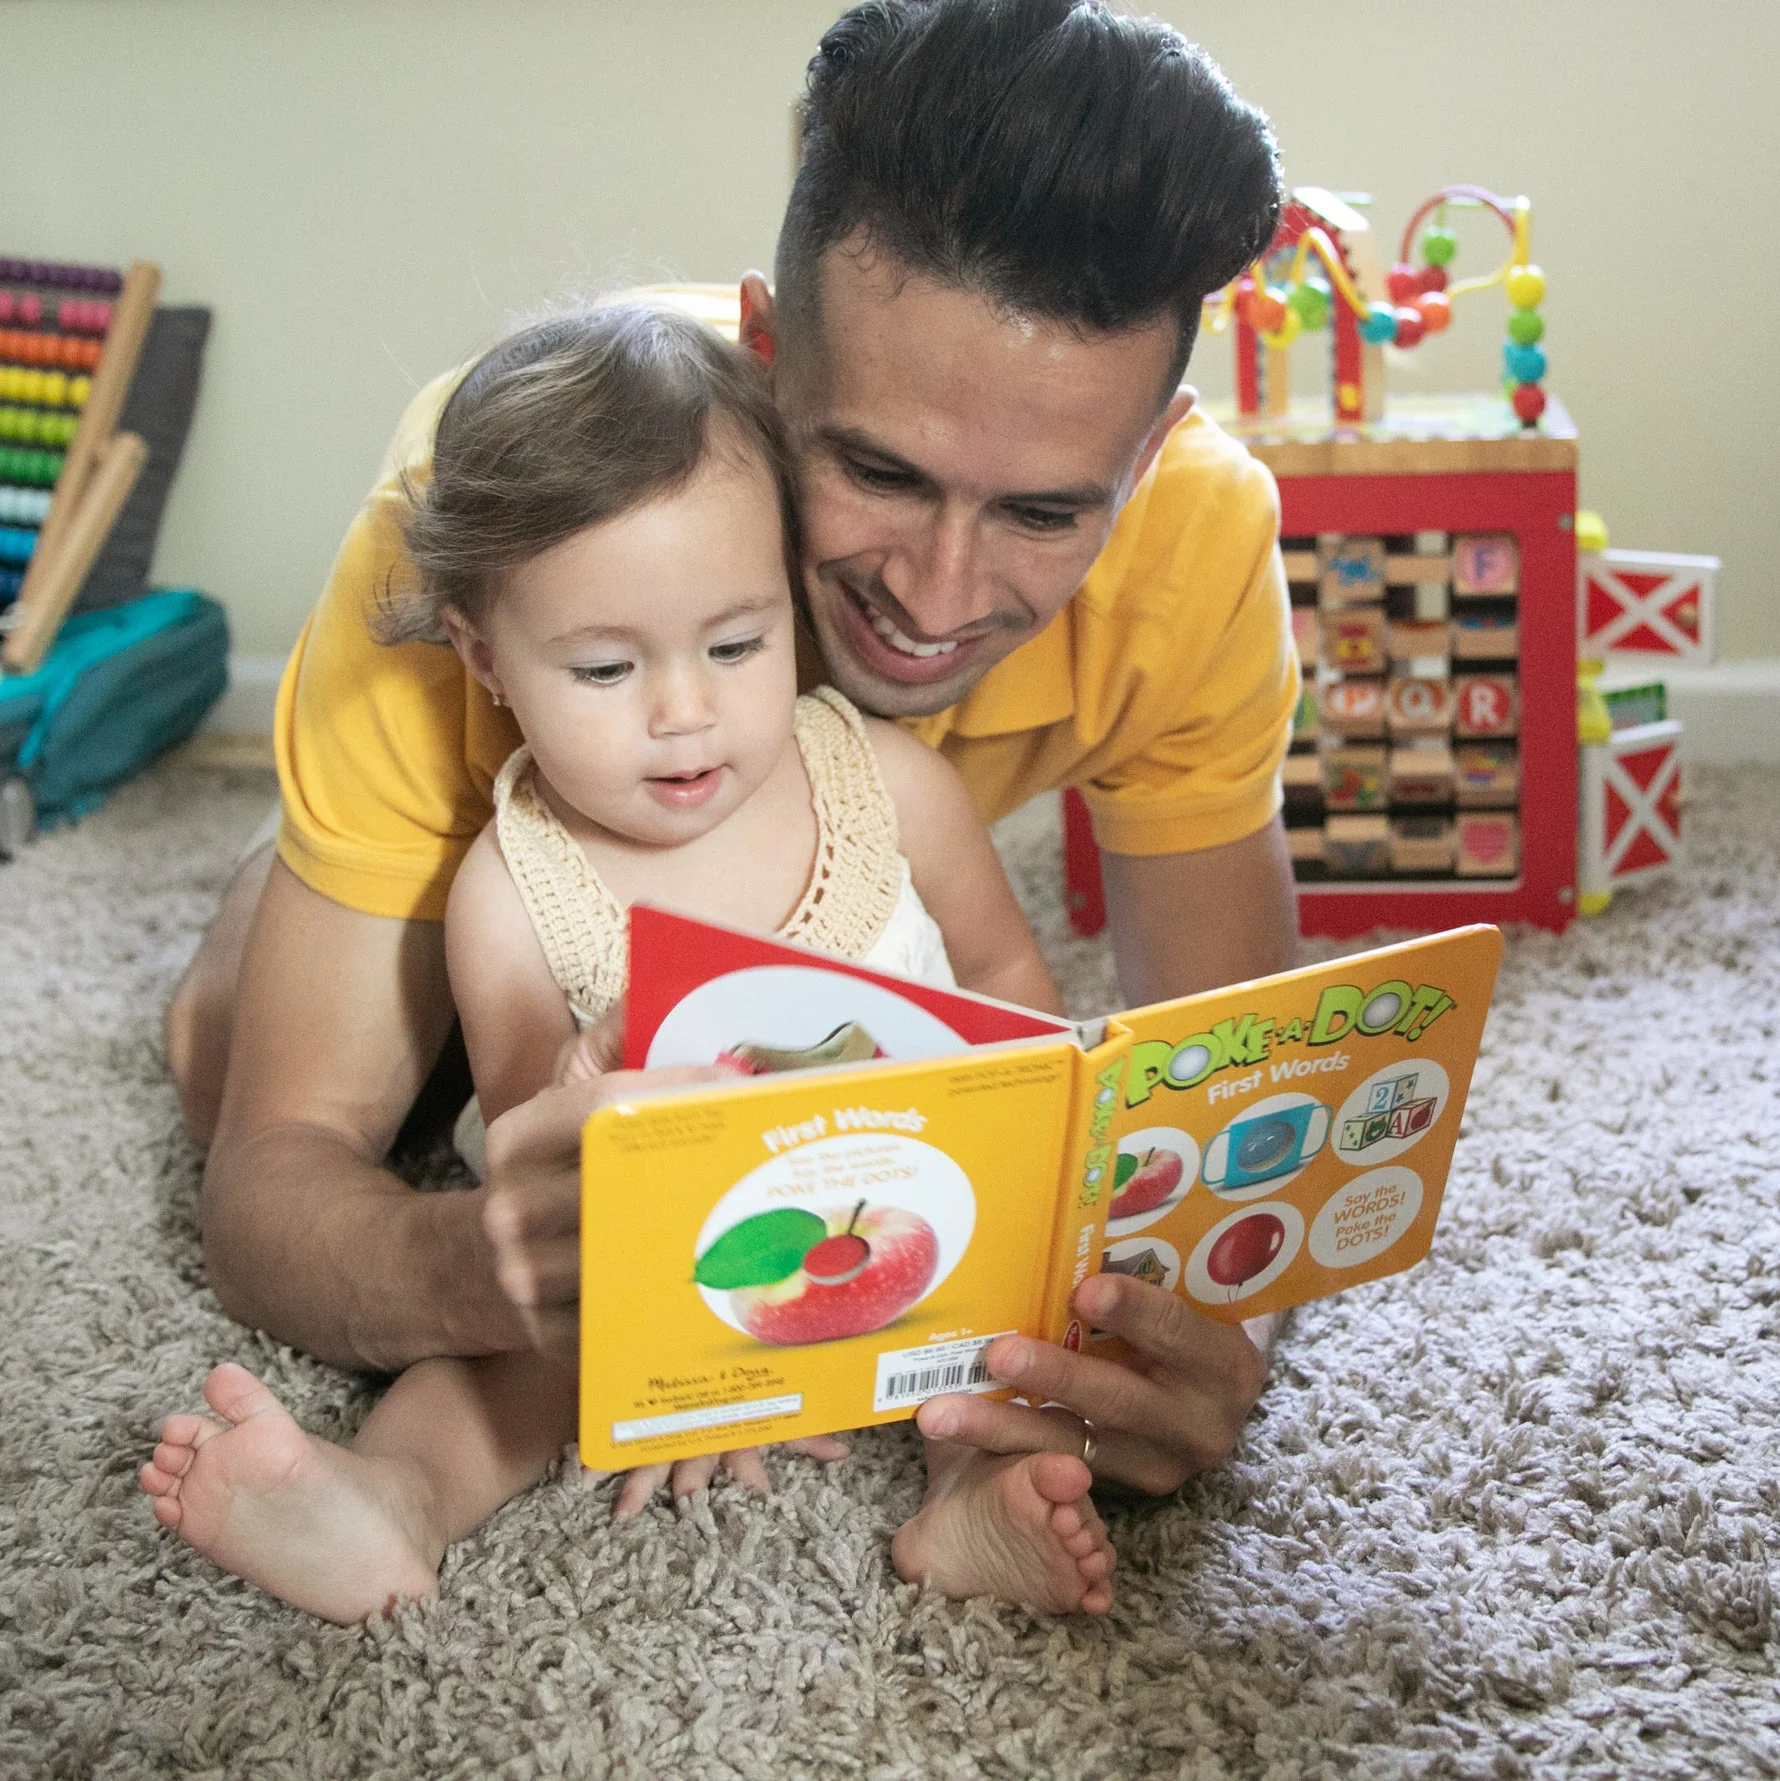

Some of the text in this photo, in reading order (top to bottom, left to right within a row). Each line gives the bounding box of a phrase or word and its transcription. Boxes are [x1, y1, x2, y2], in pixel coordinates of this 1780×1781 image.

[1469, 684, 1497, 726] R
[1207, 1051, 1351, 1105] First Words
[1373, 1087, 1389, 1110] 2
[761, 1114, 827, 1154] First
[832, 1105, 928, 1133] Words
[1389, 1112, 1403, 1135] A
[1334, 1191, 1406, 1224] WORDS!
[1343, 1183, 1397, 1207] Say the
[1336, 1211, 1397, 1238] Poke the
[1336, 1226, 1389, 1251] DOTS!
